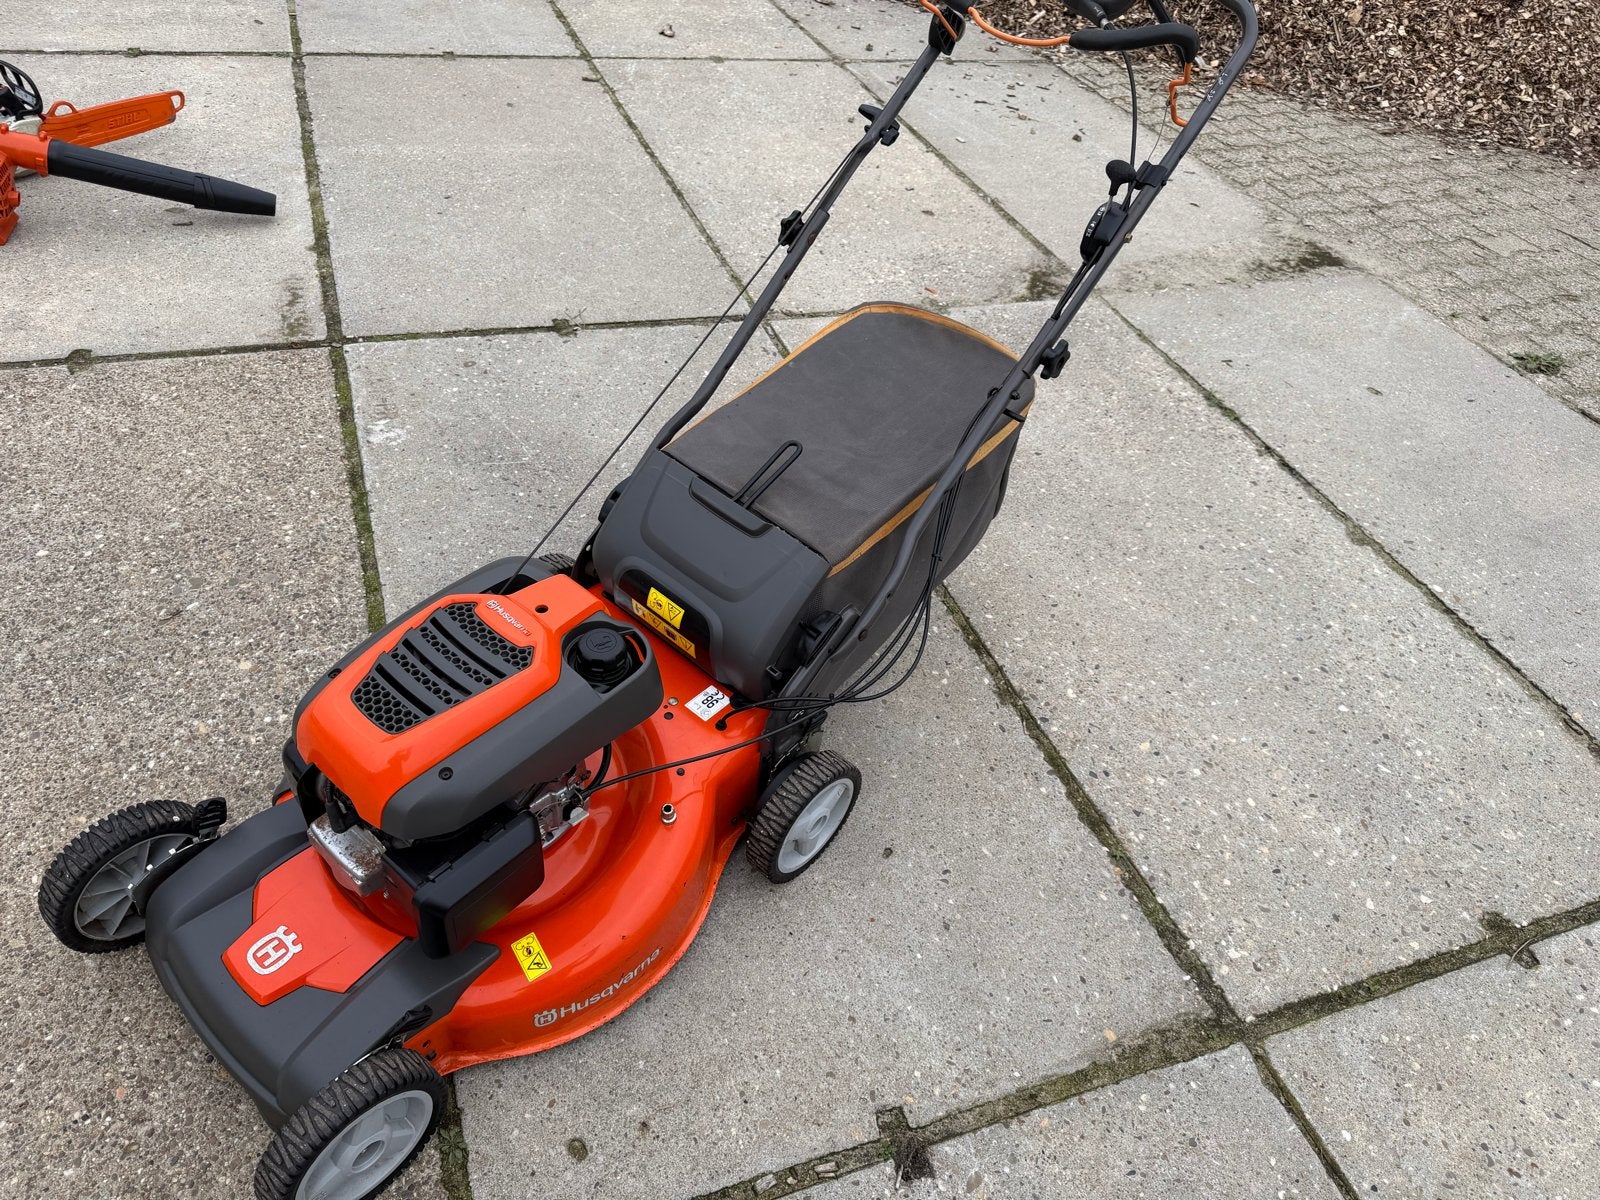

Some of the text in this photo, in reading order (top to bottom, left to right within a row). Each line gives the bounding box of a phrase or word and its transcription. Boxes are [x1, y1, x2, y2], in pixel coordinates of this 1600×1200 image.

[108, 112, 140, 129] STIHL
[494, 604, 532, 637] Husqvarna
[560, 947, 660, 1018] Husqvarna
